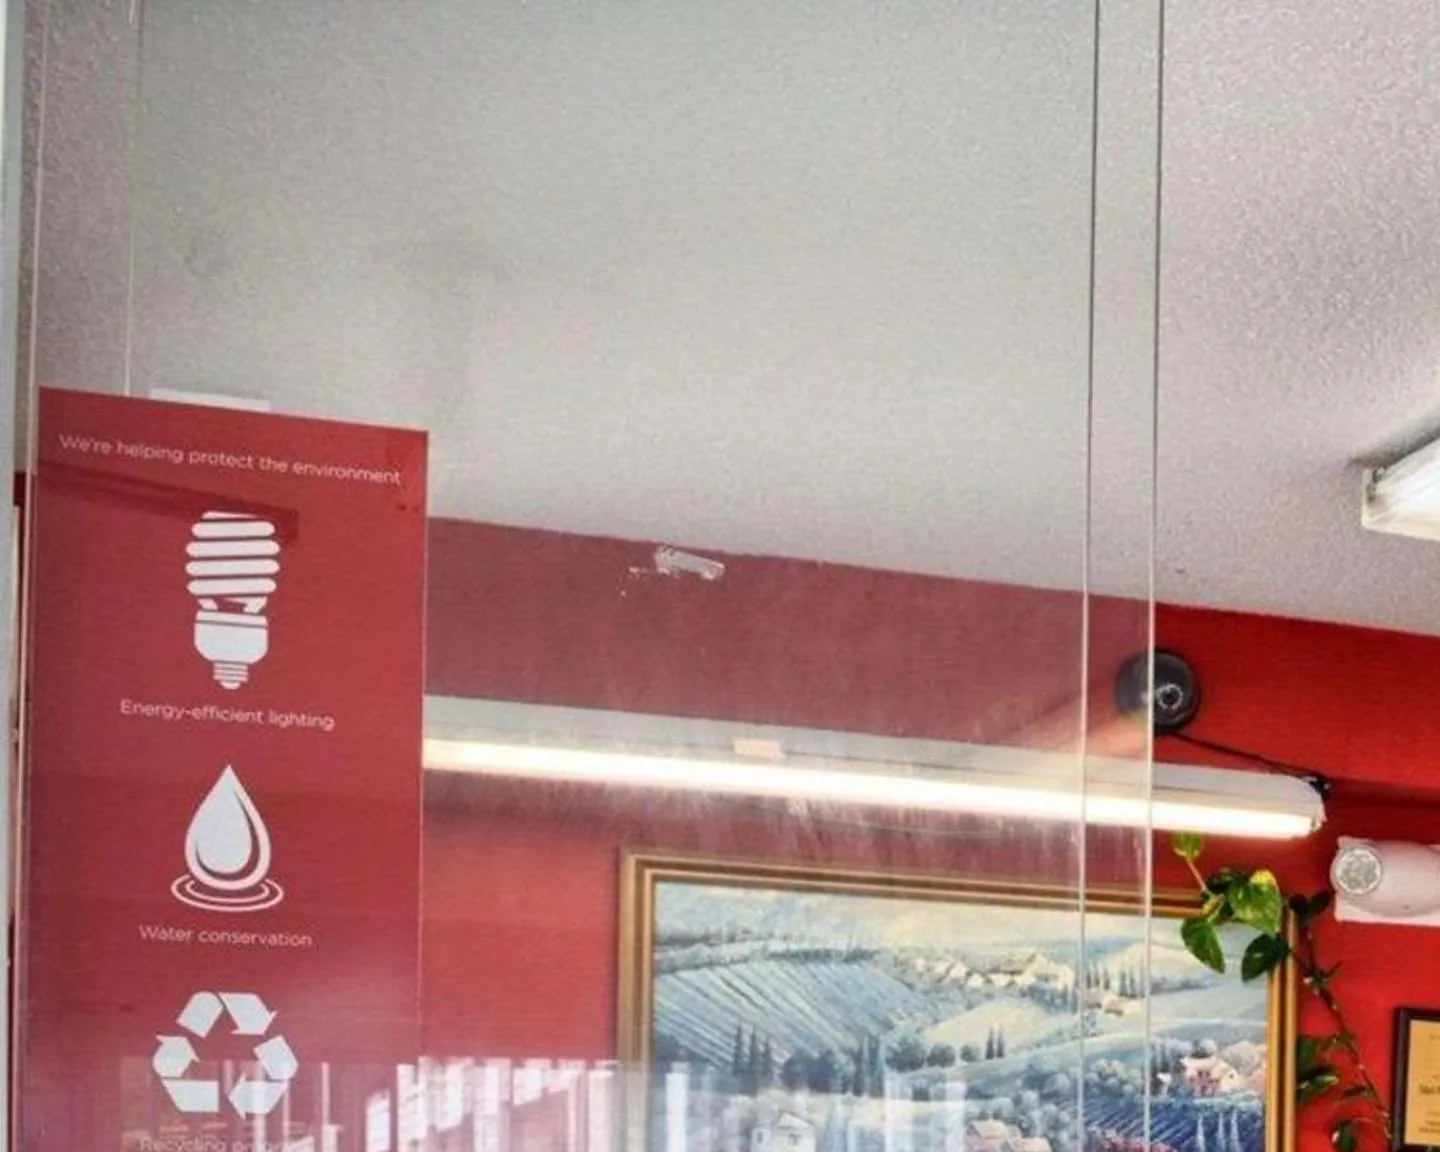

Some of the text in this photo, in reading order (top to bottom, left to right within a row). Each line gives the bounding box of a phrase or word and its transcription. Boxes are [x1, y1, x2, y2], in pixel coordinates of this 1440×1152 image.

[58, 433, 401, 486] We're helping protect the environment
[120, 699, 335, 732] Energy-efficient lighting
[138, 924, 312, 947] Water conservation
